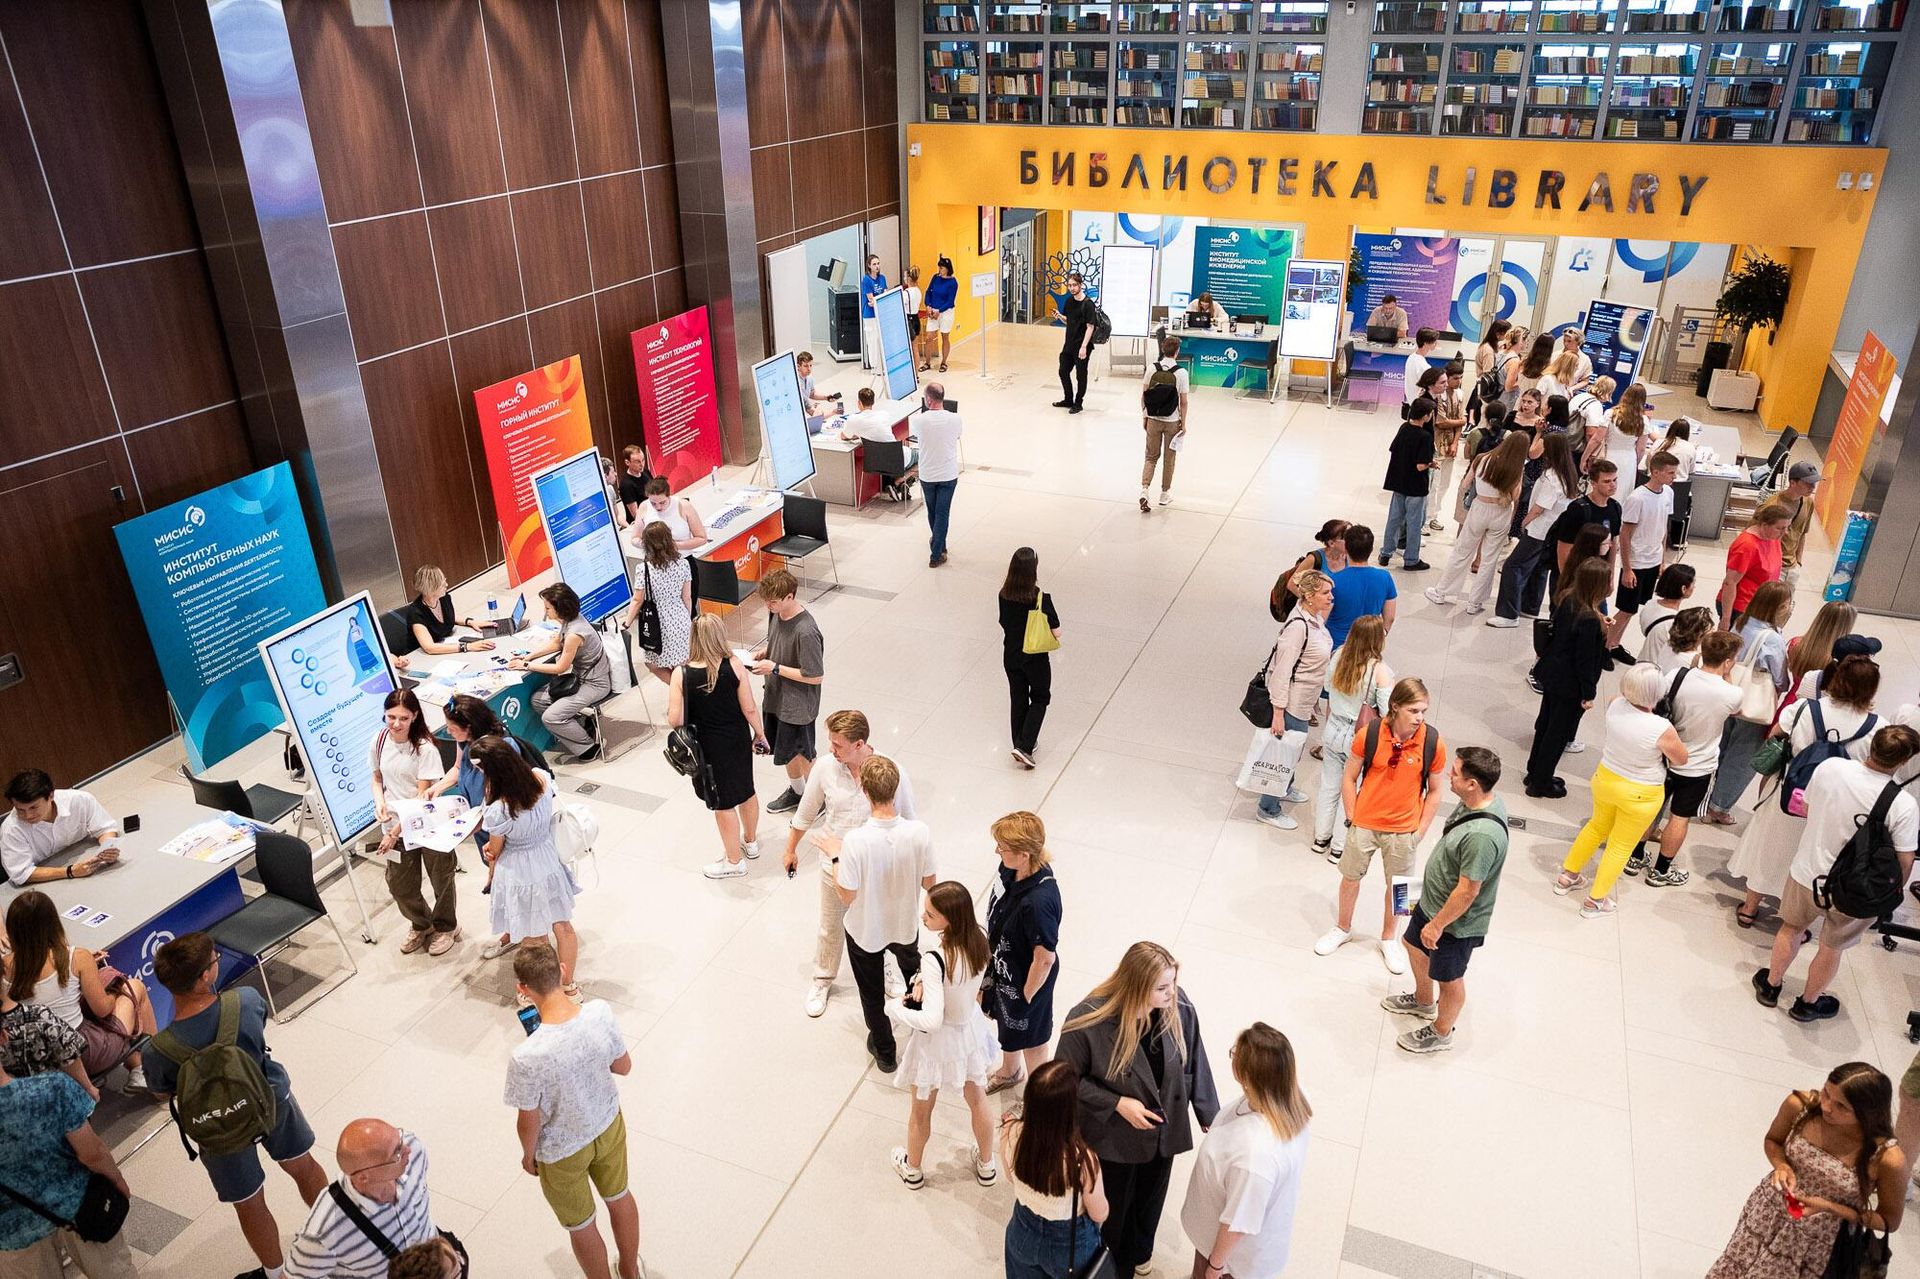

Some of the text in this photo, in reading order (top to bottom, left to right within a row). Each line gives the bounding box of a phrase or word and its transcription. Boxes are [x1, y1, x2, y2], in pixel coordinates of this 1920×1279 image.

[1019, 150, 1378, 199] БИБЛИОТЕКА
[1425, 165, 1709, 216] LIBRARY
[1210, 256, 1267, 265] БИОМЕДИЦИНСКОЙ
[497, 395, 521, 410] МИСИС
[500, 410, 528, 428] ГОРНЫЙ
[528, 398, 560, 417] ИНСТИТУТ
[154, 524, 194, 547] МИСИС
[163, 543, 218, 573] ИНСТИТУТ
[167, 541, 255, 585] КОМПЬЮТЕРНЫХ
[254, 529, 280, 546] НАУК
[173, 580, 204, 597] КЛЮЧЕВЫЕ
[205, 563, 243, 582] НАПРАВЛЕНИЯ
[181, 587, 217, 606] Робототехника
[184, 600, 209, 614] Системная
[214, 584, 244, 600] программная
[186, 599, 230, 623] Интеллектуальные
[231, 590, 250, 601] системы
[251, 581, 267, 591] анализа
[188, 604, 237, 630] Машинное обучение
[191, 624, 214, 638] Интернет
[196, 630, 238, 653] Информационные
[238, 621, 257, 632] системы
[261, 606, 285, 620] технологии
[193, 628, 224, 646] Графический
[198, 645, 225, 661] Разработка
[203, 646, 258, 676] Управление IT-проектам
[205, 668, 231, 684] Обработка
[308, 692, 364, 727] Создаем будущее
[310, 718, 333, 734] вместе
[192, 1099, 247, 1124] NIKE AIR
